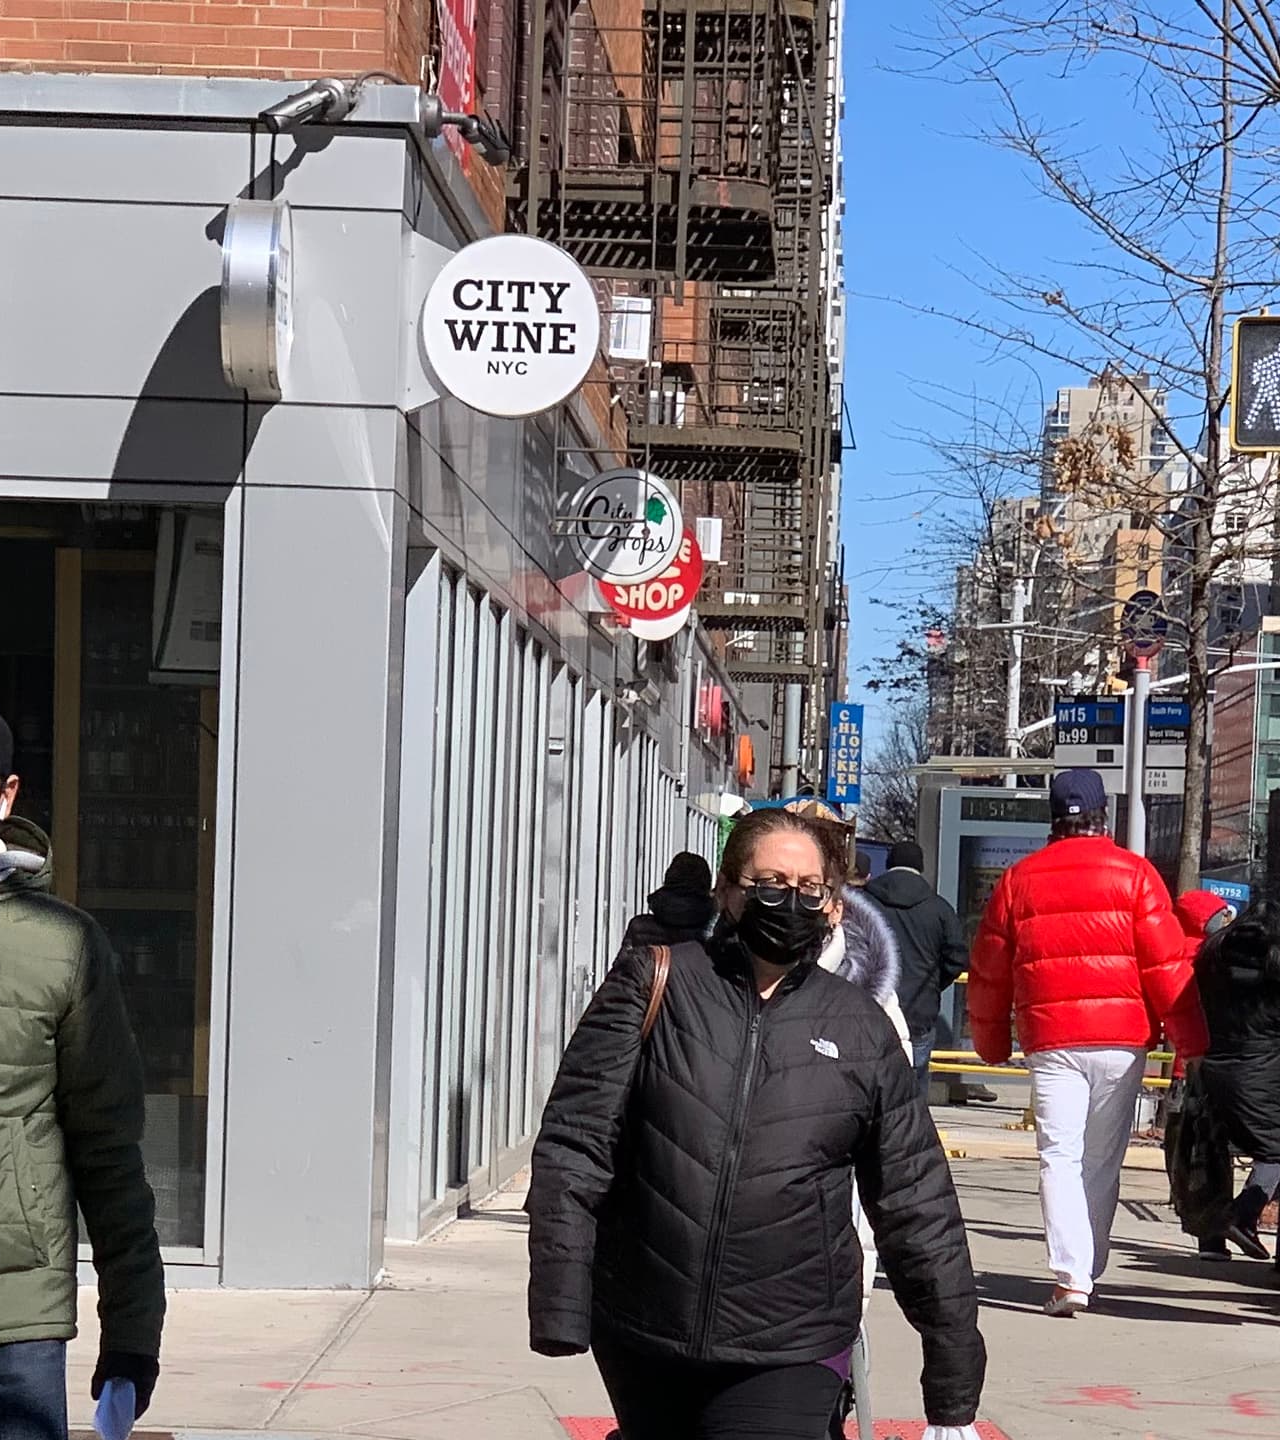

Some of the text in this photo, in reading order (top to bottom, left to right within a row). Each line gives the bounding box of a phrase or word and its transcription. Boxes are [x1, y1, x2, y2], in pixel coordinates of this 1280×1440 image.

[452, 279, 571, 314] CITY
[444, 319, 576, 354] WINE
[487, 361, 528, 375] NYC
[582, 495, 633, 540] City
[608, 525, 666, 565] Hops
[614, 582, 685, 611] SHOP
[1059, 707, 1086, 722] M15
[835, 709, 850, 797] CHICKEN
[1059, 728, 1088, 744] Bx99
